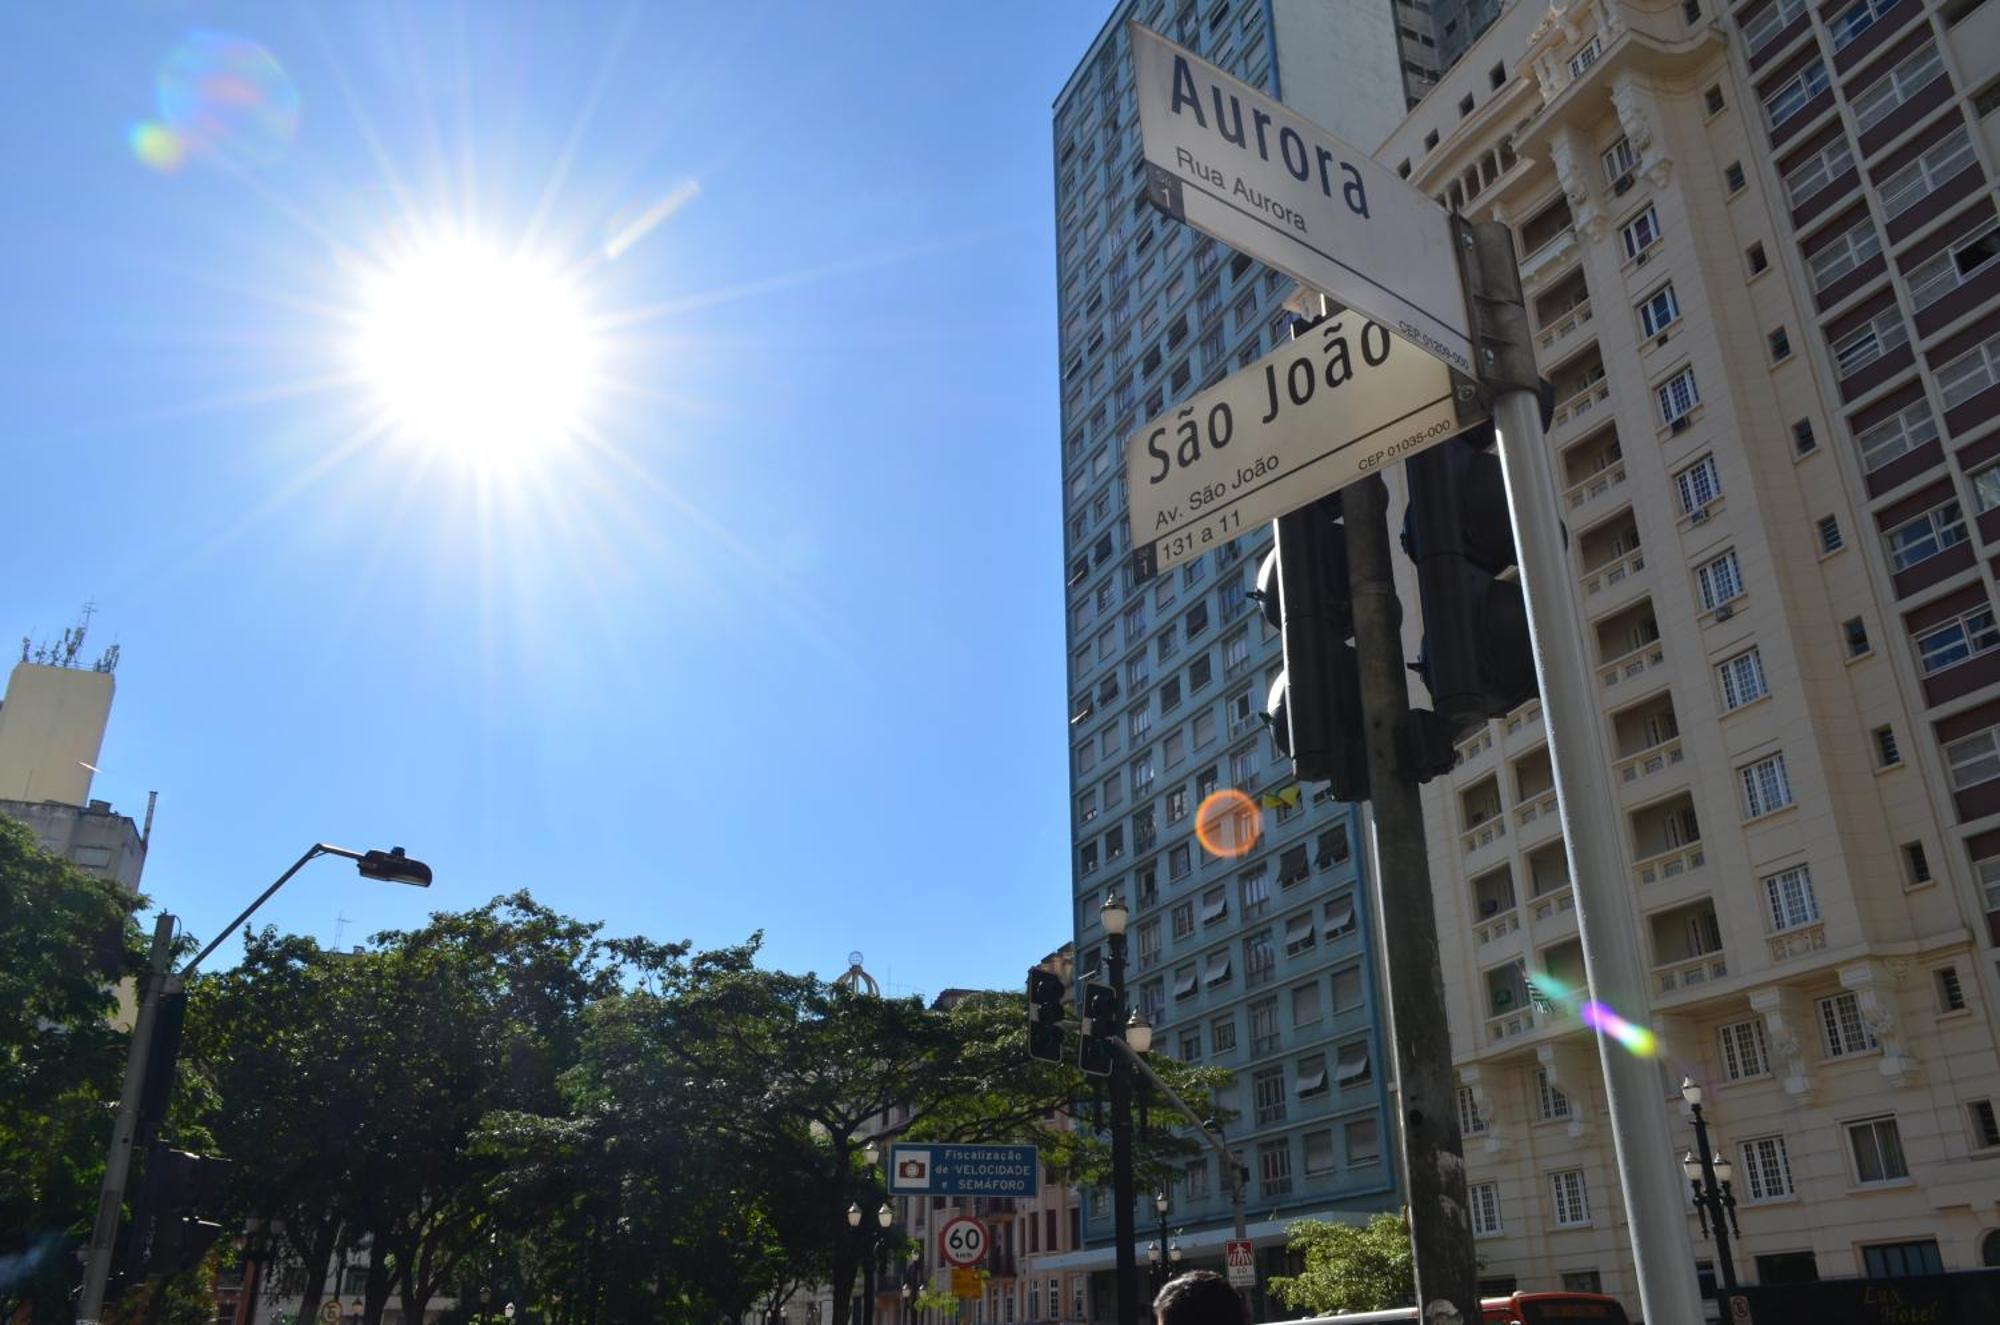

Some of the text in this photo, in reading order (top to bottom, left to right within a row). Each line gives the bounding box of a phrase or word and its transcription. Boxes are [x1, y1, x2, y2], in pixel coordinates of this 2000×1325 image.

[1171, 54, 1370, 219] Aurora
[1176, 146, 1226, 190] Rua
[1233, 178, 1308, 233] Aurora
[1399, 320, 1421, 340] CEP
[1148, 320, 1391, 485] São João
[1358, 419, 1451, 471] CEP 01035-000
[1155, 455, 1280, 530] Av. São João
[1162, 532, 1194, 561] 131
[1200, 528, 1213, 544] a
[1219, 510, 1241, 533] 11
[935, 1165, 1031, 1176] de VELOCIDADE
[945, 1149, 1022, 1161] Fiscalização
[958, 1177, 1025, 1190] SEMÁFORO
[949, 1228, 980, 1250] 60
